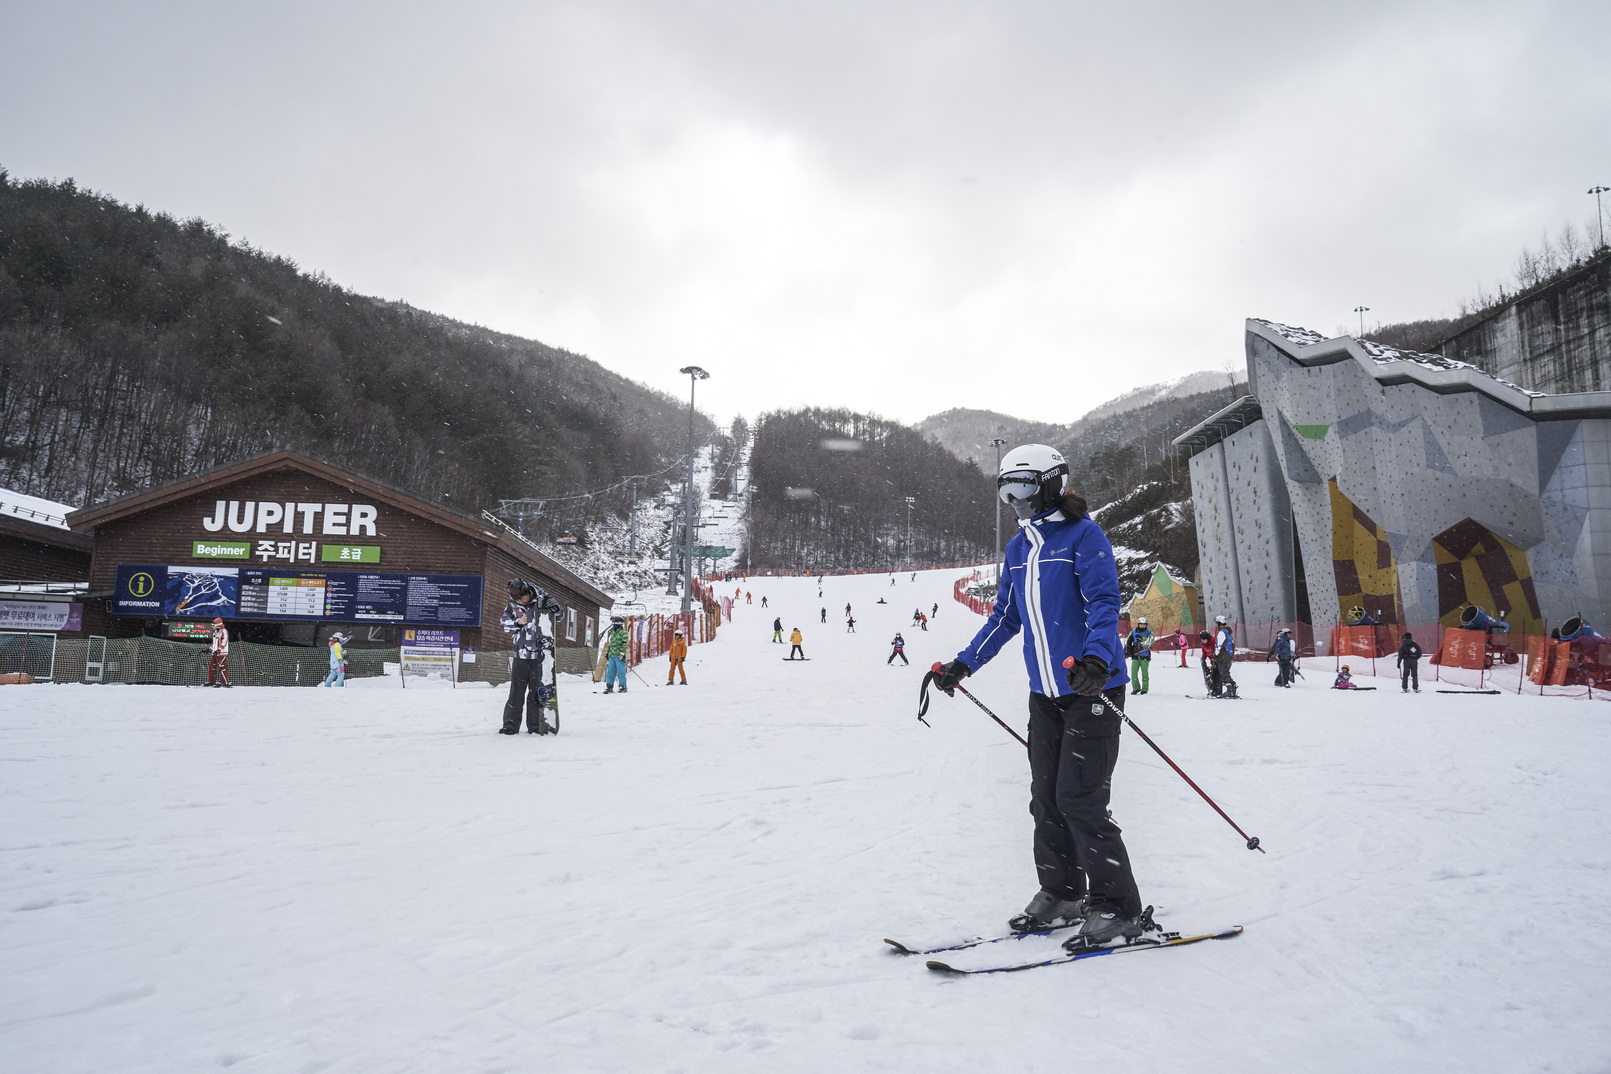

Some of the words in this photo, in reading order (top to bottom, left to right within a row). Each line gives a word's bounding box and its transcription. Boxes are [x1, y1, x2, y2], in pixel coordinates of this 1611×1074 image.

[203, 500, 378, 536] JUPITER
[197, 544, 245, 556] Beginner
[255, 541, 317, 563] 주피터
[340, 548, 362, 560] 초급
[119, 600, 160, 608] INFORMATION
[11, 611, 35, 621] 무료대여
